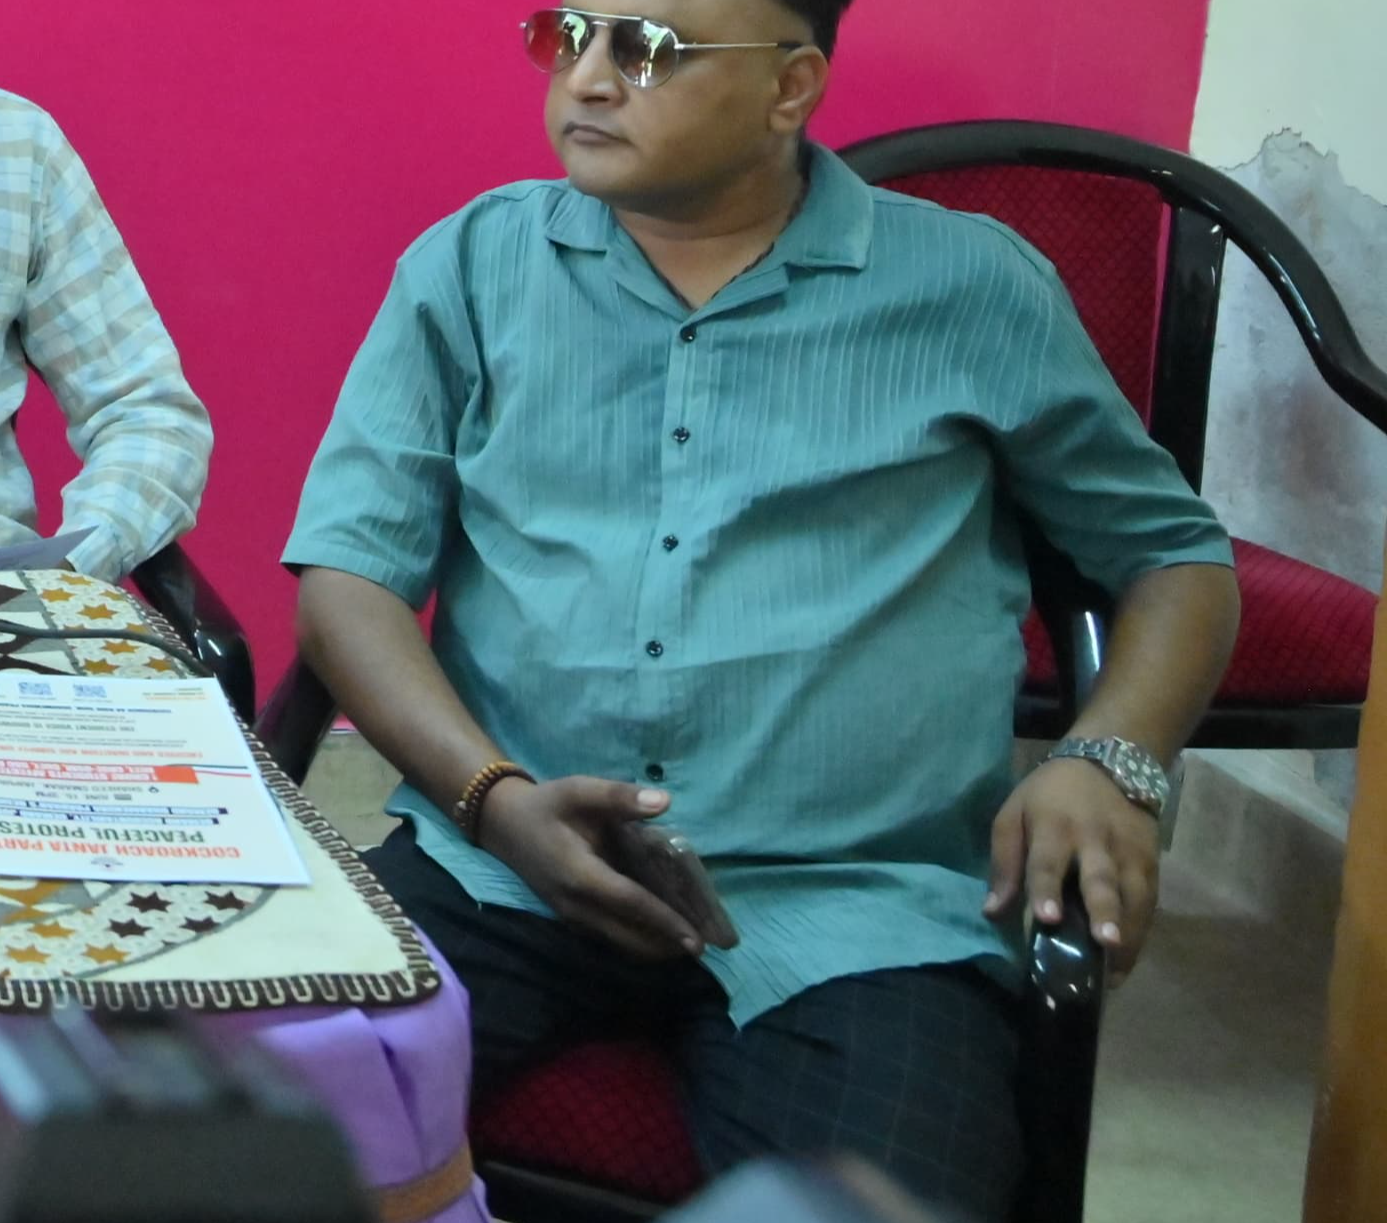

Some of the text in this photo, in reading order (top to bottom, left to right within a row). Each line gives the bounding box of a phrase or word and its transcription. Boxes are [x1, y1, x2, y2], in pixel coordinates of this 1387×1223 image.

[95, 827, 205, 843] PEACEFUL
[49, 839, 108, 854] JANTA
[114, 843, 241, 859] COCKROACH
